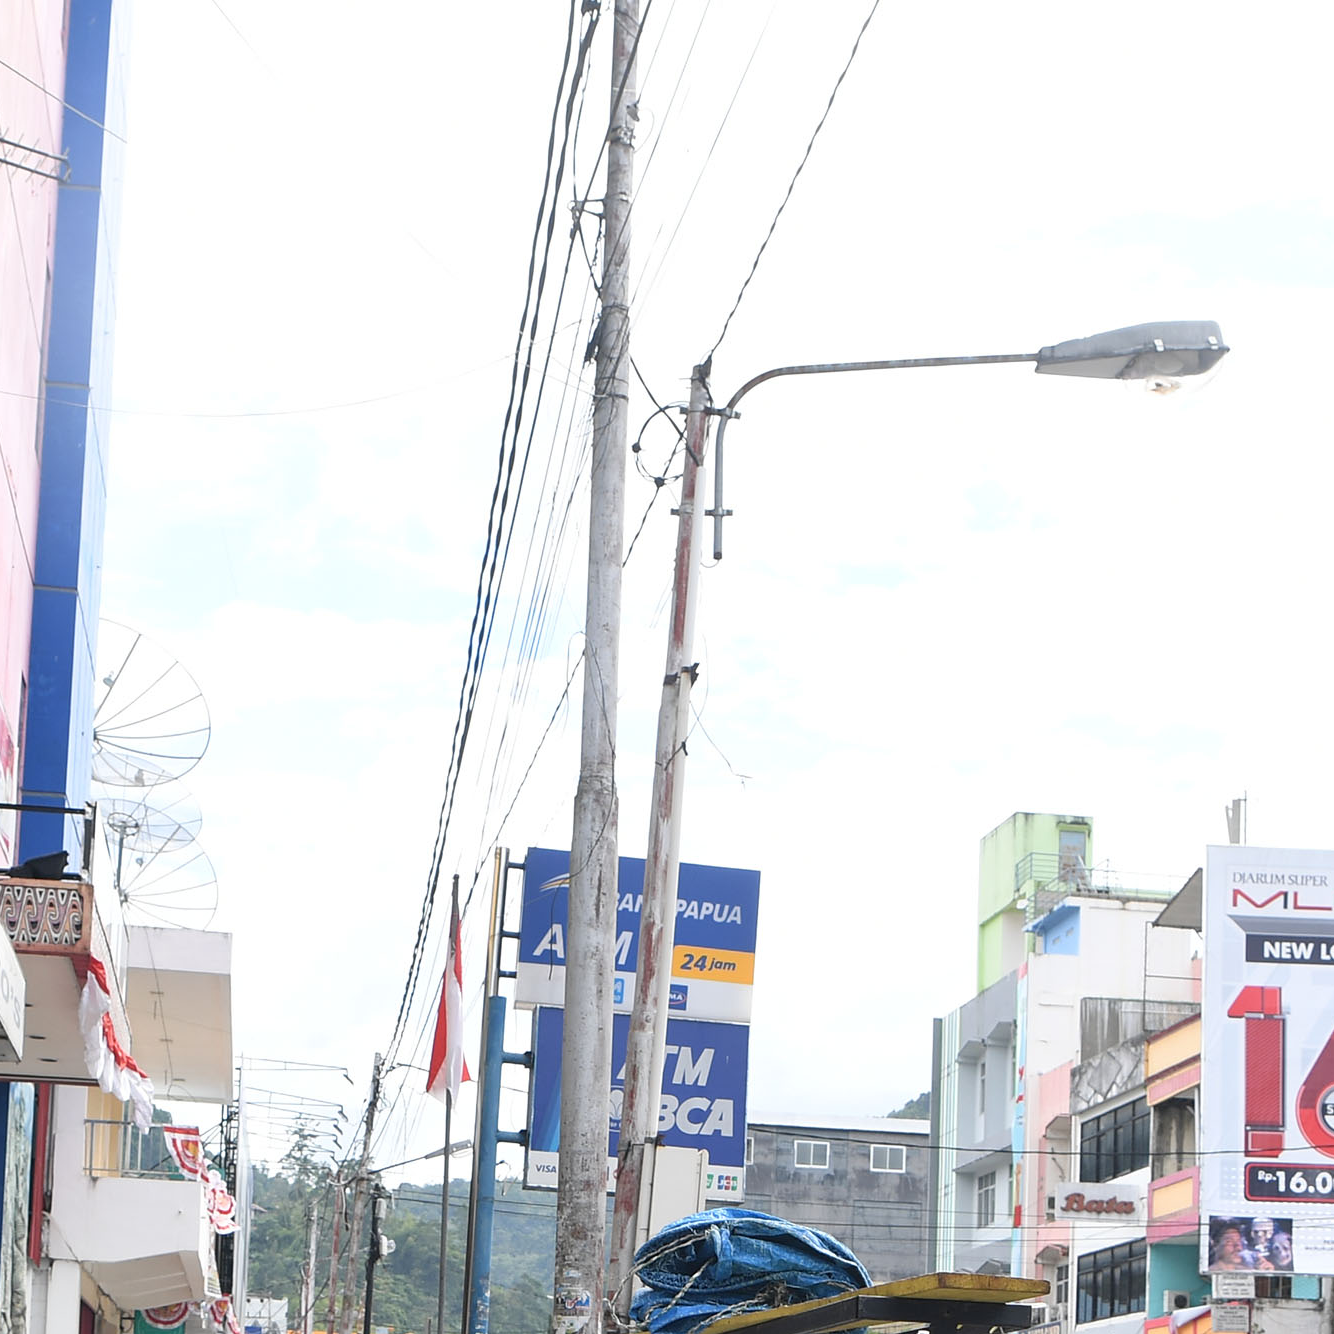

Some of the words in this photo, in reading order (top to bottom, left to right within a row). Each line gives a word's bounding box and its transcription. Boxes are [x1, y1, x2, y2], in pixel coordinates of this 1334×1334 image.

[1232, 870, 1284, 887] DJARUM
[1287, 872, 1328, 887] SUPER
[1263, 939, 1314, 962] NEW
[679, 953, 706, 972] 24
[708, 957, 737, 973] jam
[535, 1163, 557, 1174] VISA
[1060, 1191, 1135, 1214] Bata
